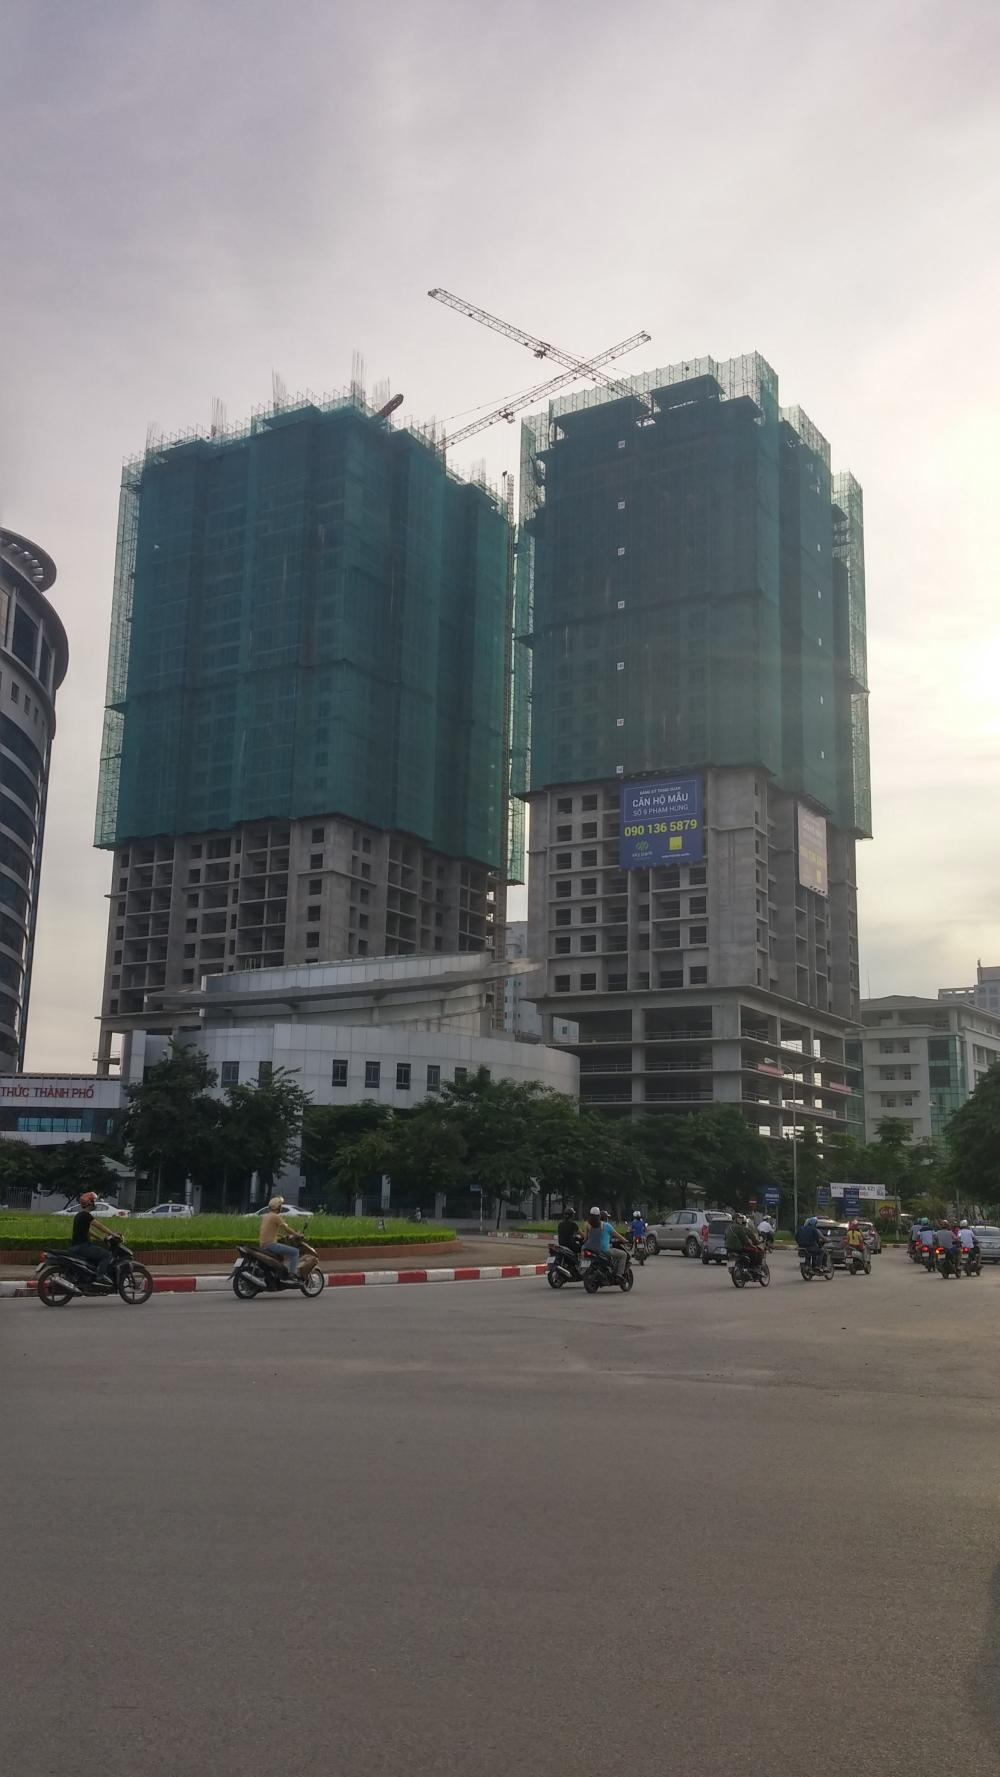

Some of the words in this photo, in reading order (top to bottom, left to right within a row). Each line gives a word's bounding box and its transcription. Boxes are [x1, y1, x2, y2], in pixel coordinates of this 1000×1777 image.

[632, 796, 651, 807] CĂN
[653, 793, 666, 805] HỘ
[624, 825, 644, 836] 090
[647, 822, 667, 834] 136
[669, 818, 697, 832] 5879
[34, 1085, 69, 1098] THÀNH
[72, 1084, 95, 1098] PHỐ
